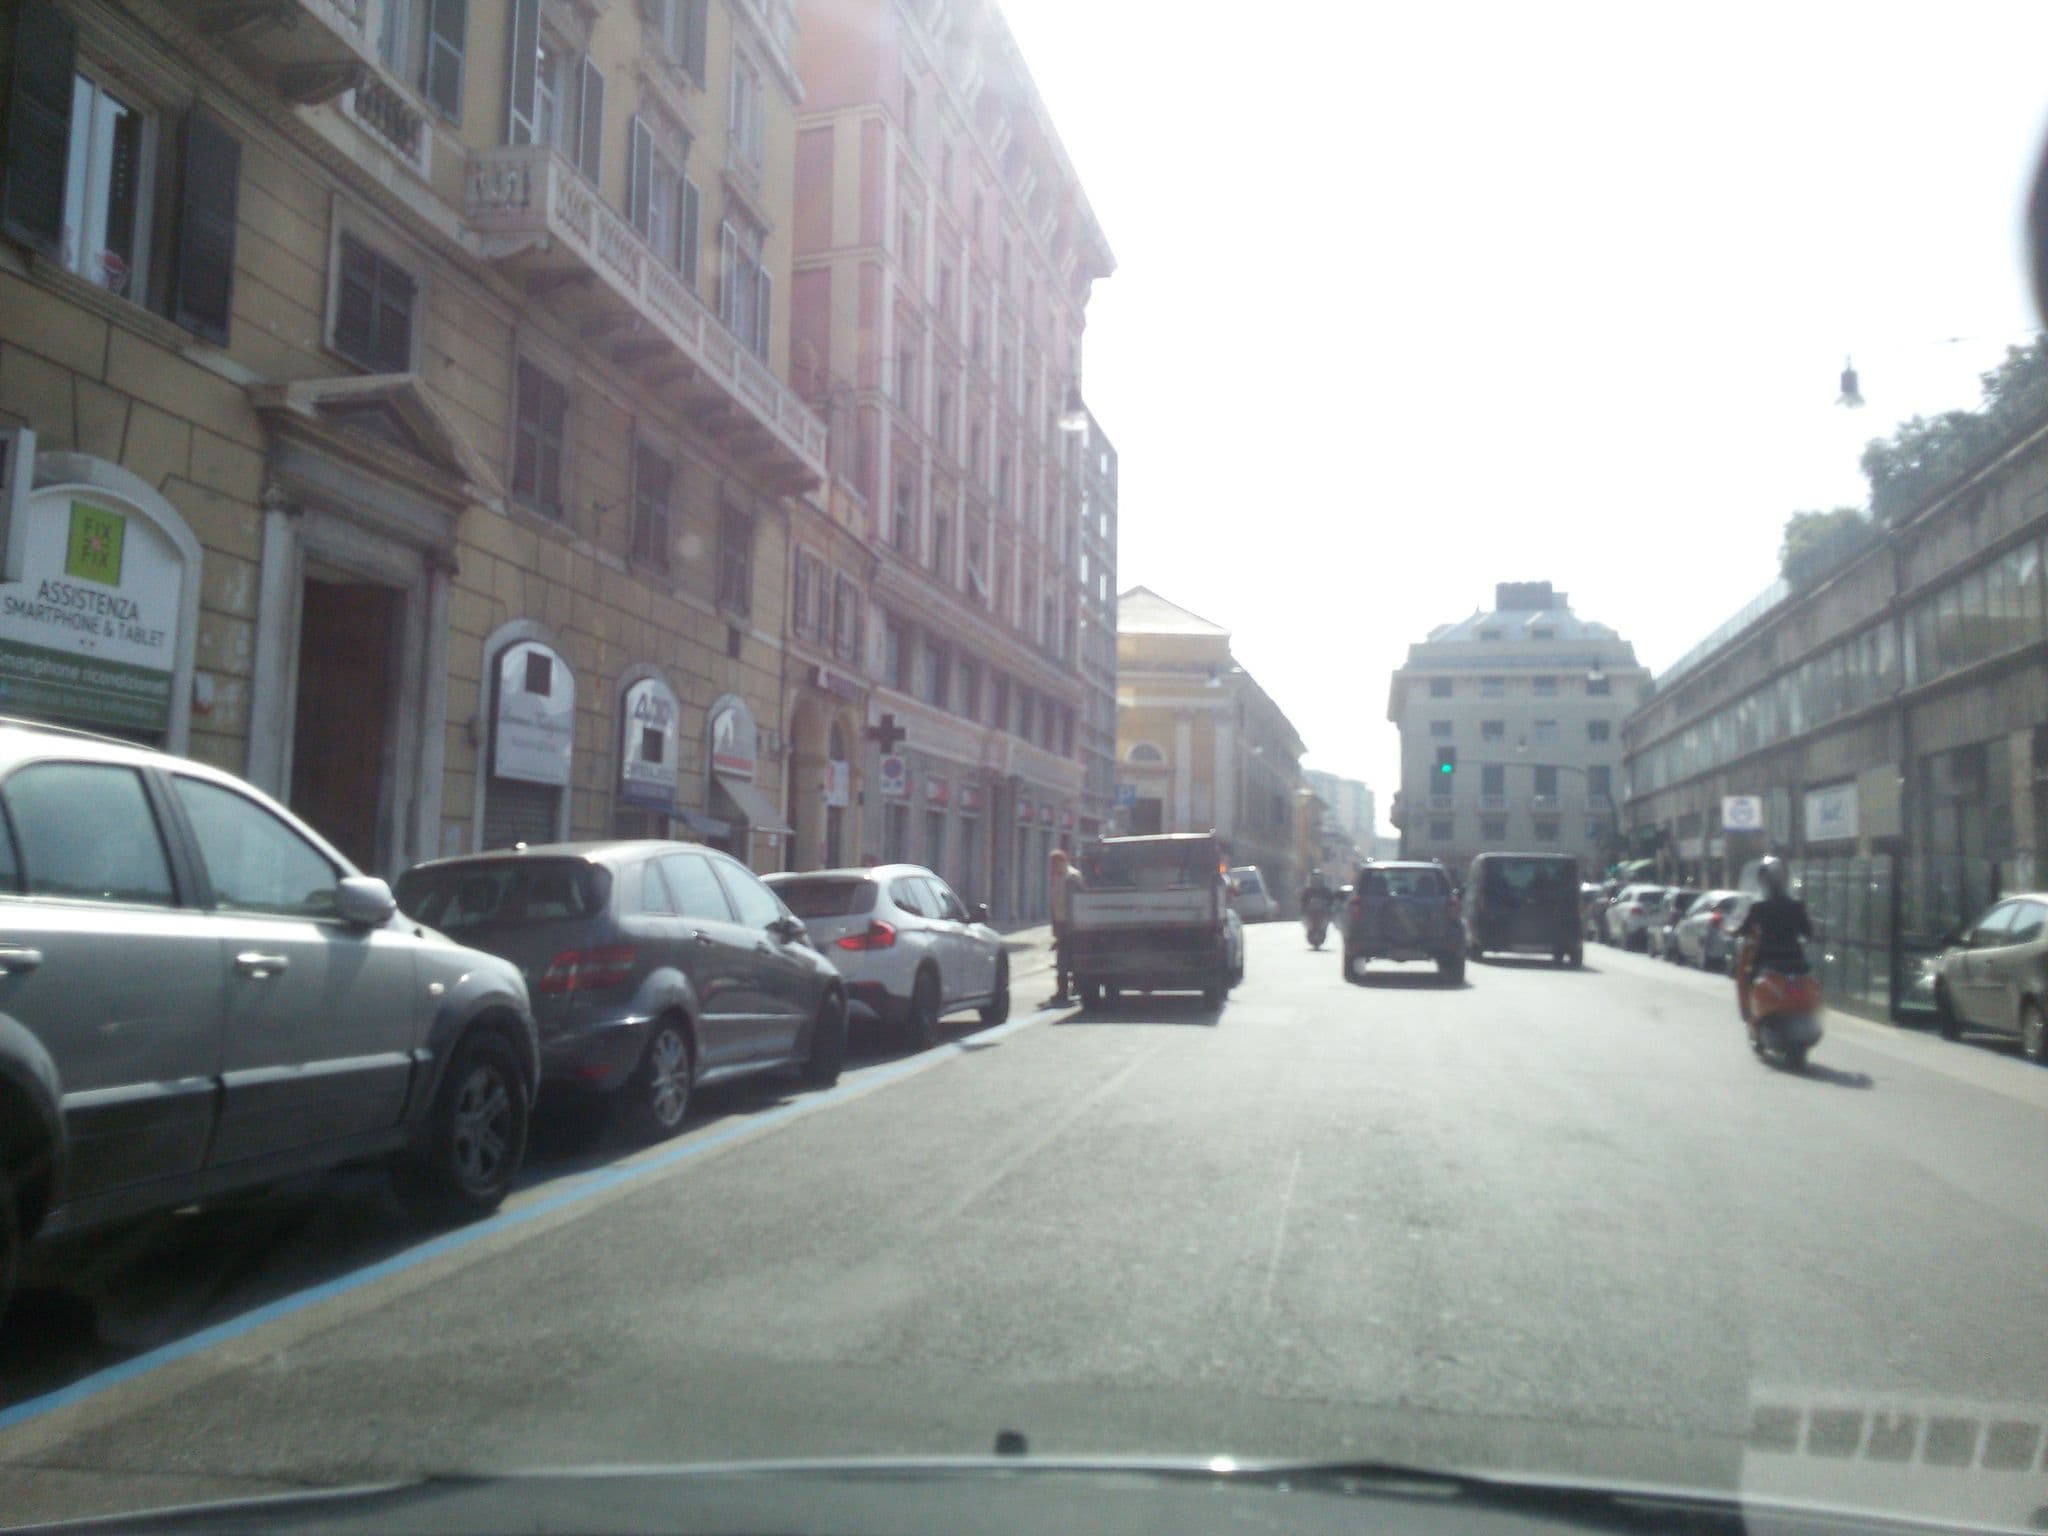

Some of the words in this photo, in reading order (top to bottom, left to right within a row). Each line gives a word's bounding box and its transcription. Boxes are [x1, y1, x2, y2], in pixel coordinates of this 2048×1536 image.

[3, 596, 99, 634] SMARTPHONE
[103, 619, 114, 638] &
[118, 622, 166, 647] TABLET
[37, 578, 140, 621] ASSISTENZA
